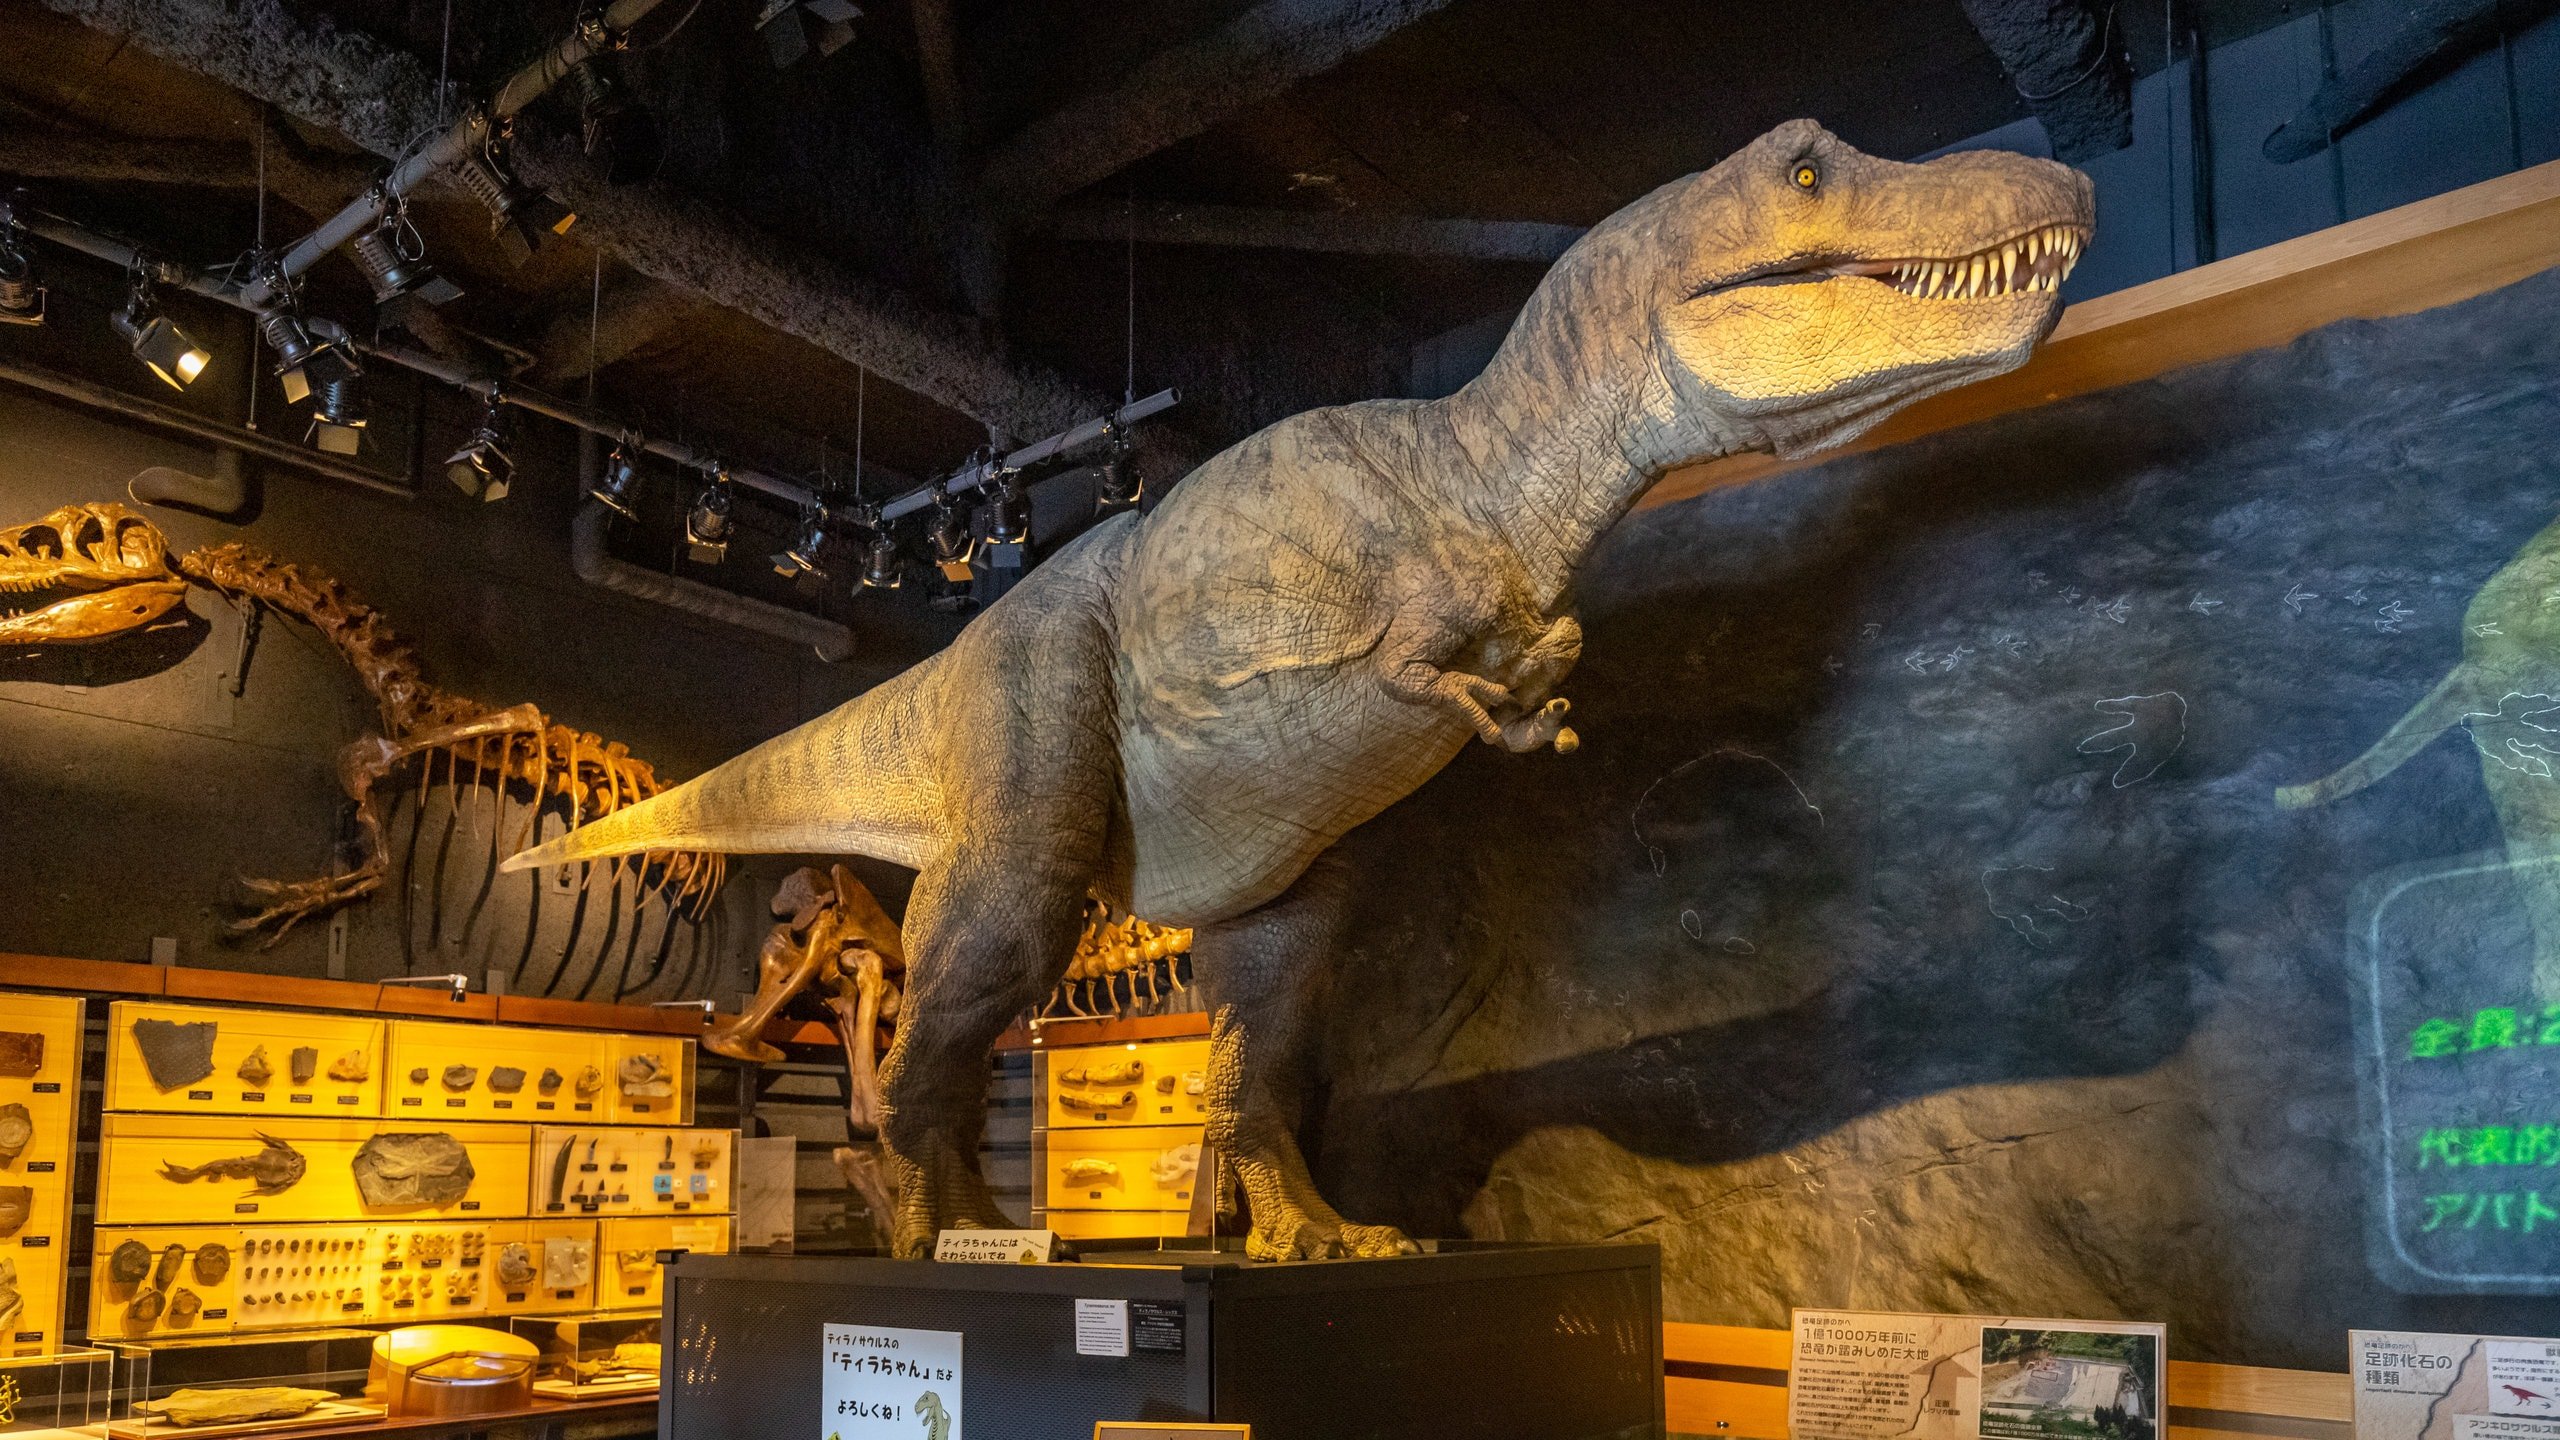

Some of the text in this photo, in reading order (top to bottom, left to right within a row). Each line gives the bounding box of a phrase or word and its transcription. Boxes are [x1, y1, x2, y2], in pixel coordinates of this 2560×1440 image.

[943, 1238, 1018, 1248] ティラちゃんには
[940, 1251, 1006, 1260] さわらないでね
[827, 1333, 899, 1350] ティラノサウルスの
[1804, 1328, 1917, 1344] 1億1000万年前に
[1800, 1342, 1929, 1361] 恐竜が踏みしめた大地
[2365, 1351, 2453, 1369] 足跡化石の
[2366, 1370, 2400, 1386] 種類
